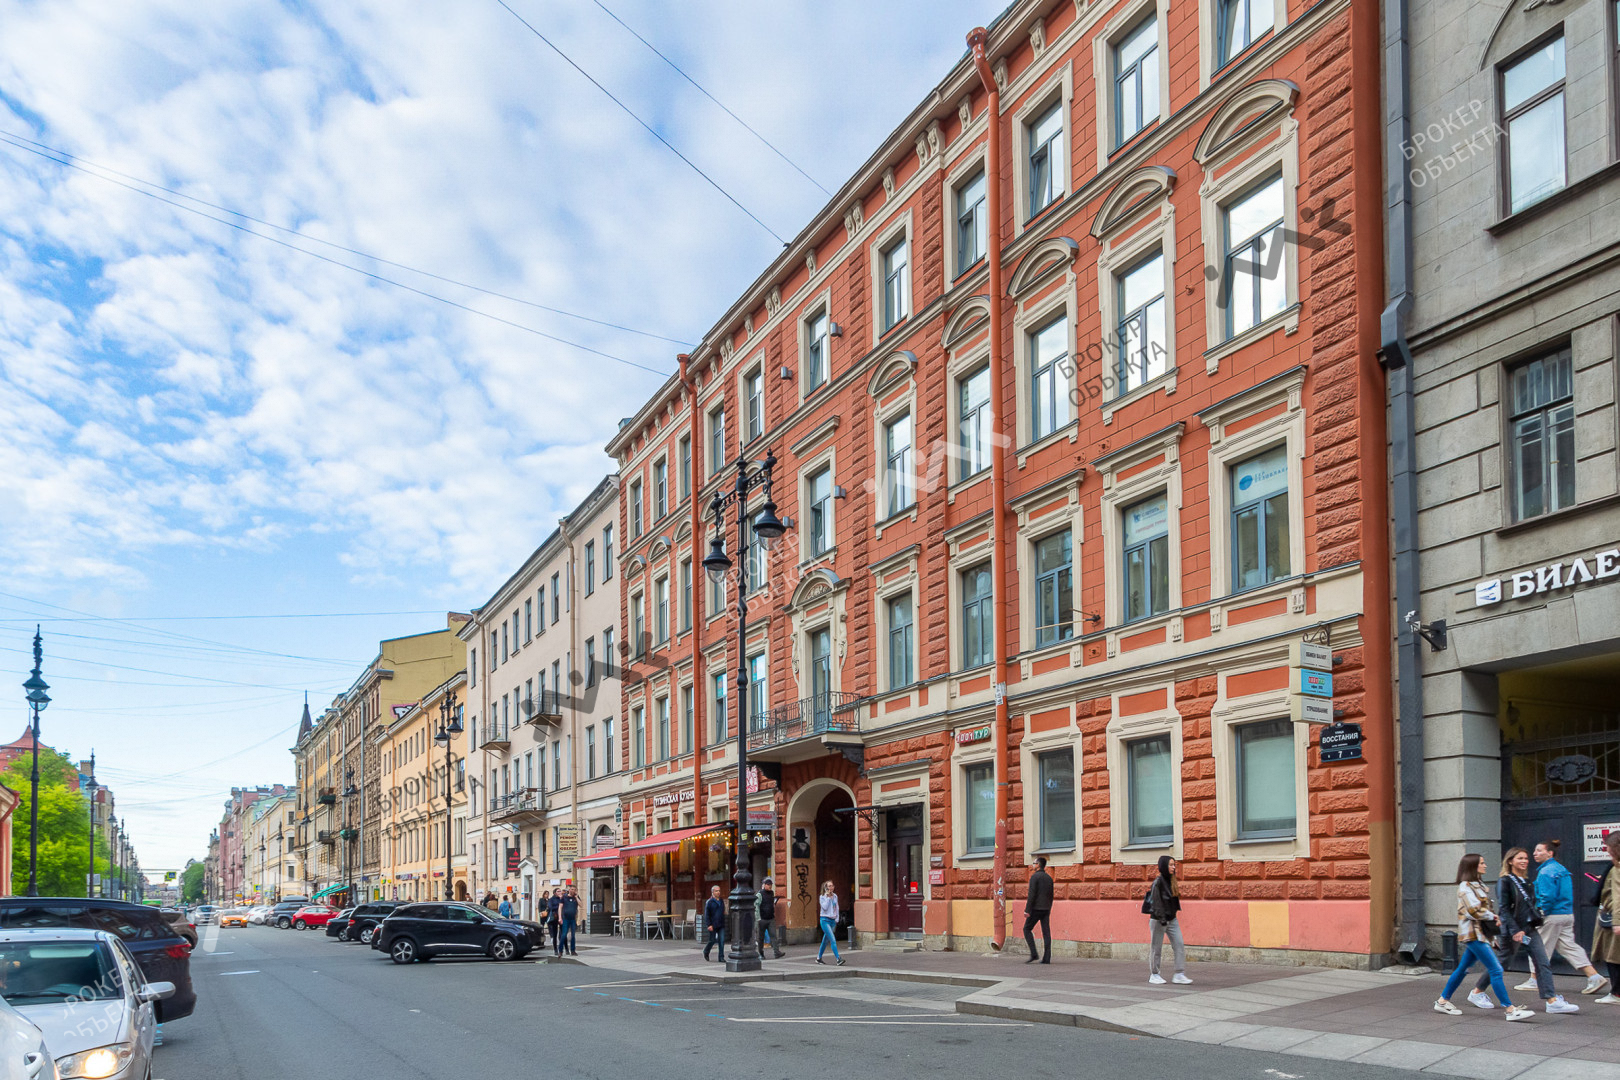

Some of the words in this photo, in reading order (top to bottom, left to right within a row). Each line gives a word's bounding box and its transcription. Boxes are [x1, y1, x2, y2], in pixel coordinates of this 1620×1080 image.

[1511, 549, 1620, 599] БИЛЕ
[1322, 732, 1359, 744] ВОССТАНИЯ
[1338, 750, 1343, 759] 7
